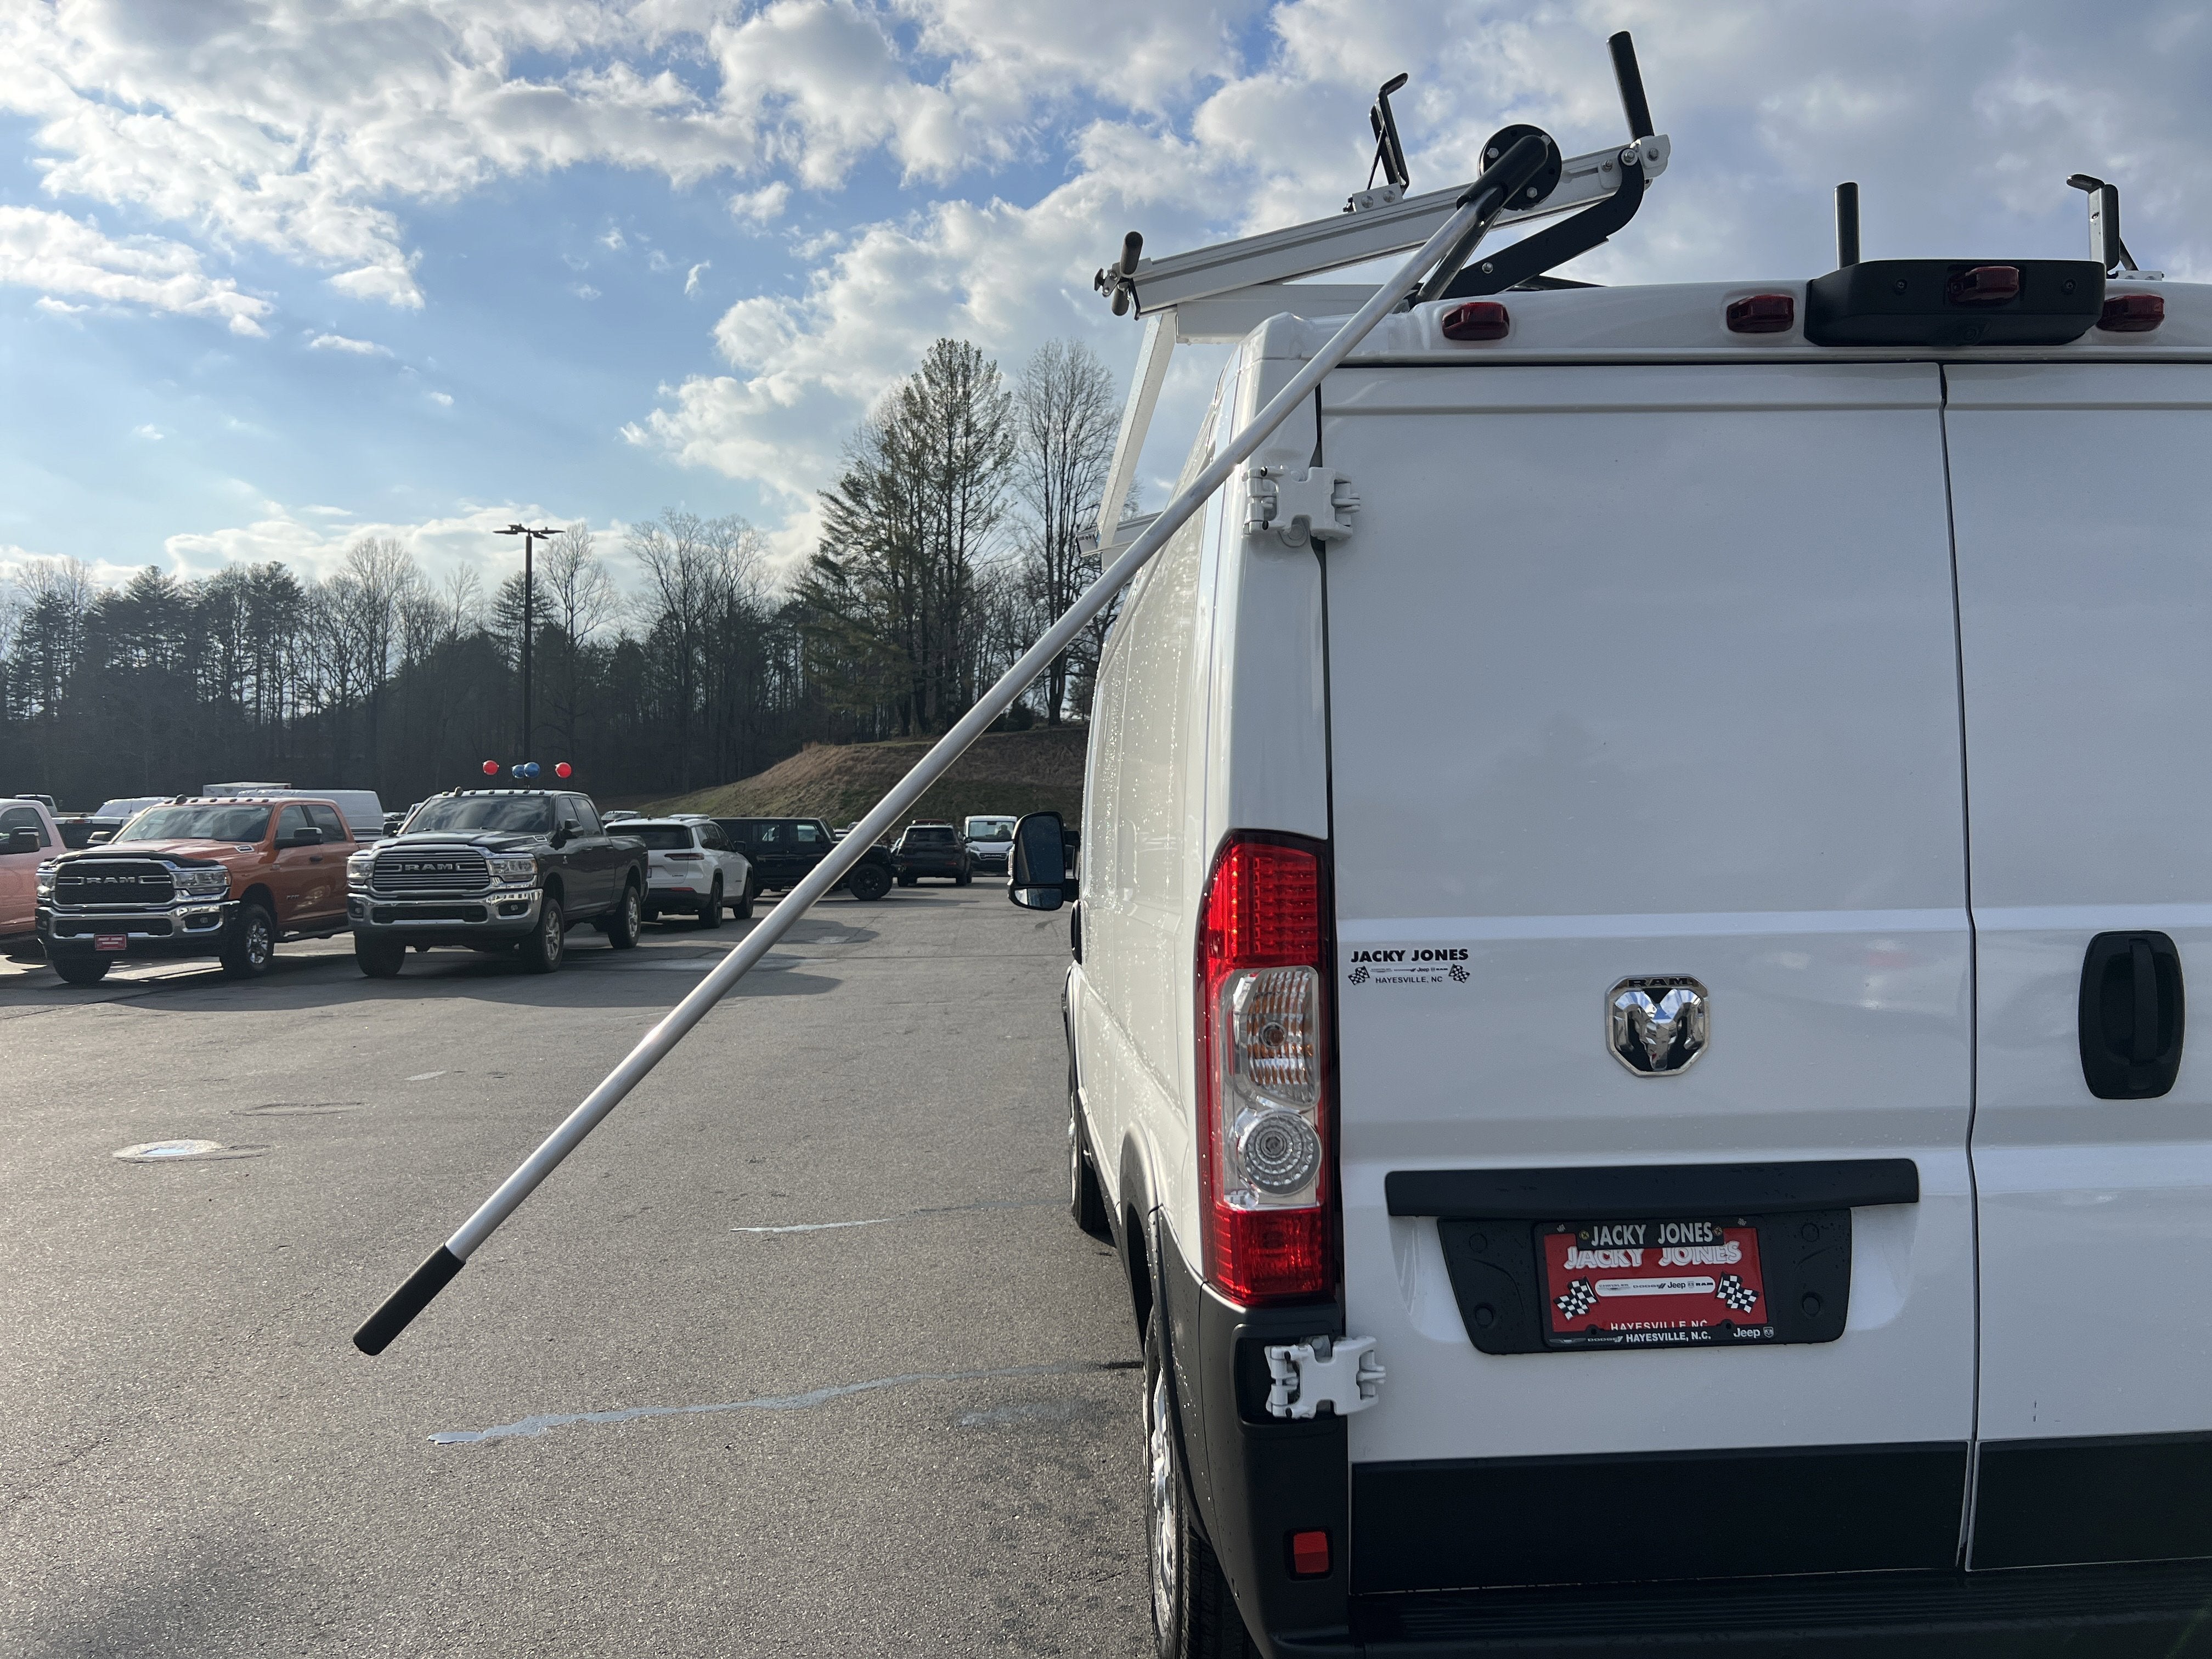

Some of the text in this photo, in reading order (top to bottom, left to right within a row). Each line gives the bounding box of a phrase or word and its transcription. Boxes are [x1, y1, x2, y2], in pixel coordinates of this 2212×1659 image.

[1351, 949, 1469, 962] JACKY JONES
[1628, 978, 1688, 987] RAM
[1591, 1222, 1713, 1246] JACKY JONES
[1564, 1240, 1742, 1269] JACKY JONES
[1626, 1332, 1689, 1342] HAYESVILLE,
[1691, 1331, 1711, 1340] N.C.
[1733, 1328, 1760, 1339] Jeep
